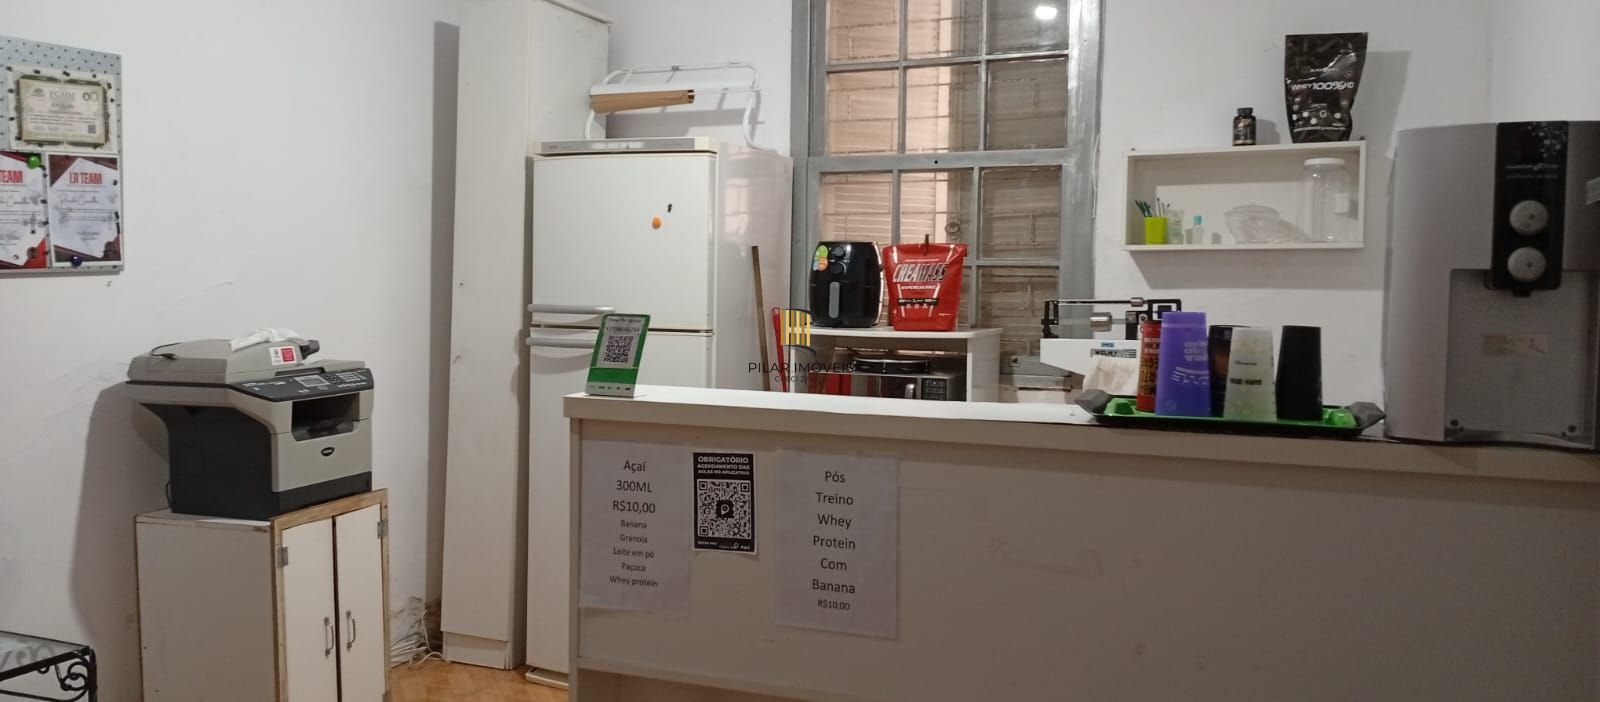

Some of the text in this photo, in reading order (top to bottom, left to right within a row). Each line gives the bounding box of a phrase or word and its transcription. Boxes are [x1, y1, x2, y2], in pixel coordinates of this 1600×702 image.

[69, 172, 103, 185] LR TEAM
[697, 455, 750, 464] OBRIGATÓRIO
[623, 459, 647, 474] Açaí
[824, 470, 846, 483] Pós
[615, 479, 653, 493] 300ML
[815, 491, 854, 506] Treino
[612, 499, 657, 514] R$10,00
[620, 519, 648, 528] Banana
[817, 513, 852, 530] Whey
[619, 533, 648, 543] Granola
[812, 535, 856, 550] Protein
[612, 547, 631, 556] Leite
[621, 562, 647, 572] Paçoca
[820, 557, 847, 571] Com
[608, 575, 658, 587] Whey protein
[811, 578, 856, 594] Banana
[817, 599, 850, 611] R$10,00
